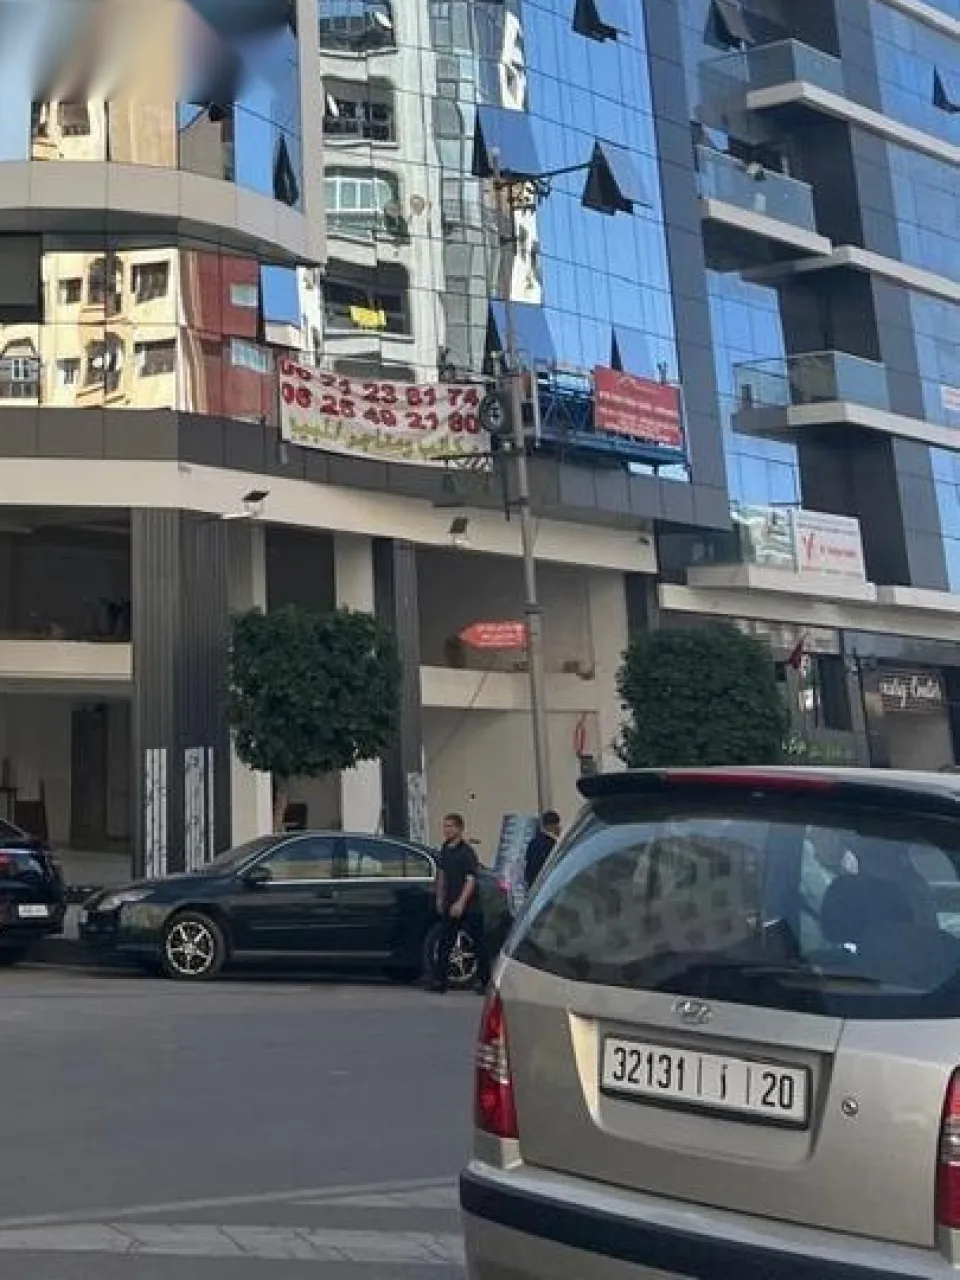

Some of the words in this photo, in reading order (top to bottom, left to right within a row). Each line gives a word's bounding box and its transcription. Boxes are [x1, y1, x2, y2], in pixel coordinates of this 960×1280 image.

[362, 383, 398, 403] 23
[613, 1047, 684, 1091] 32131
[760, 1071, 795, 1109] 20
